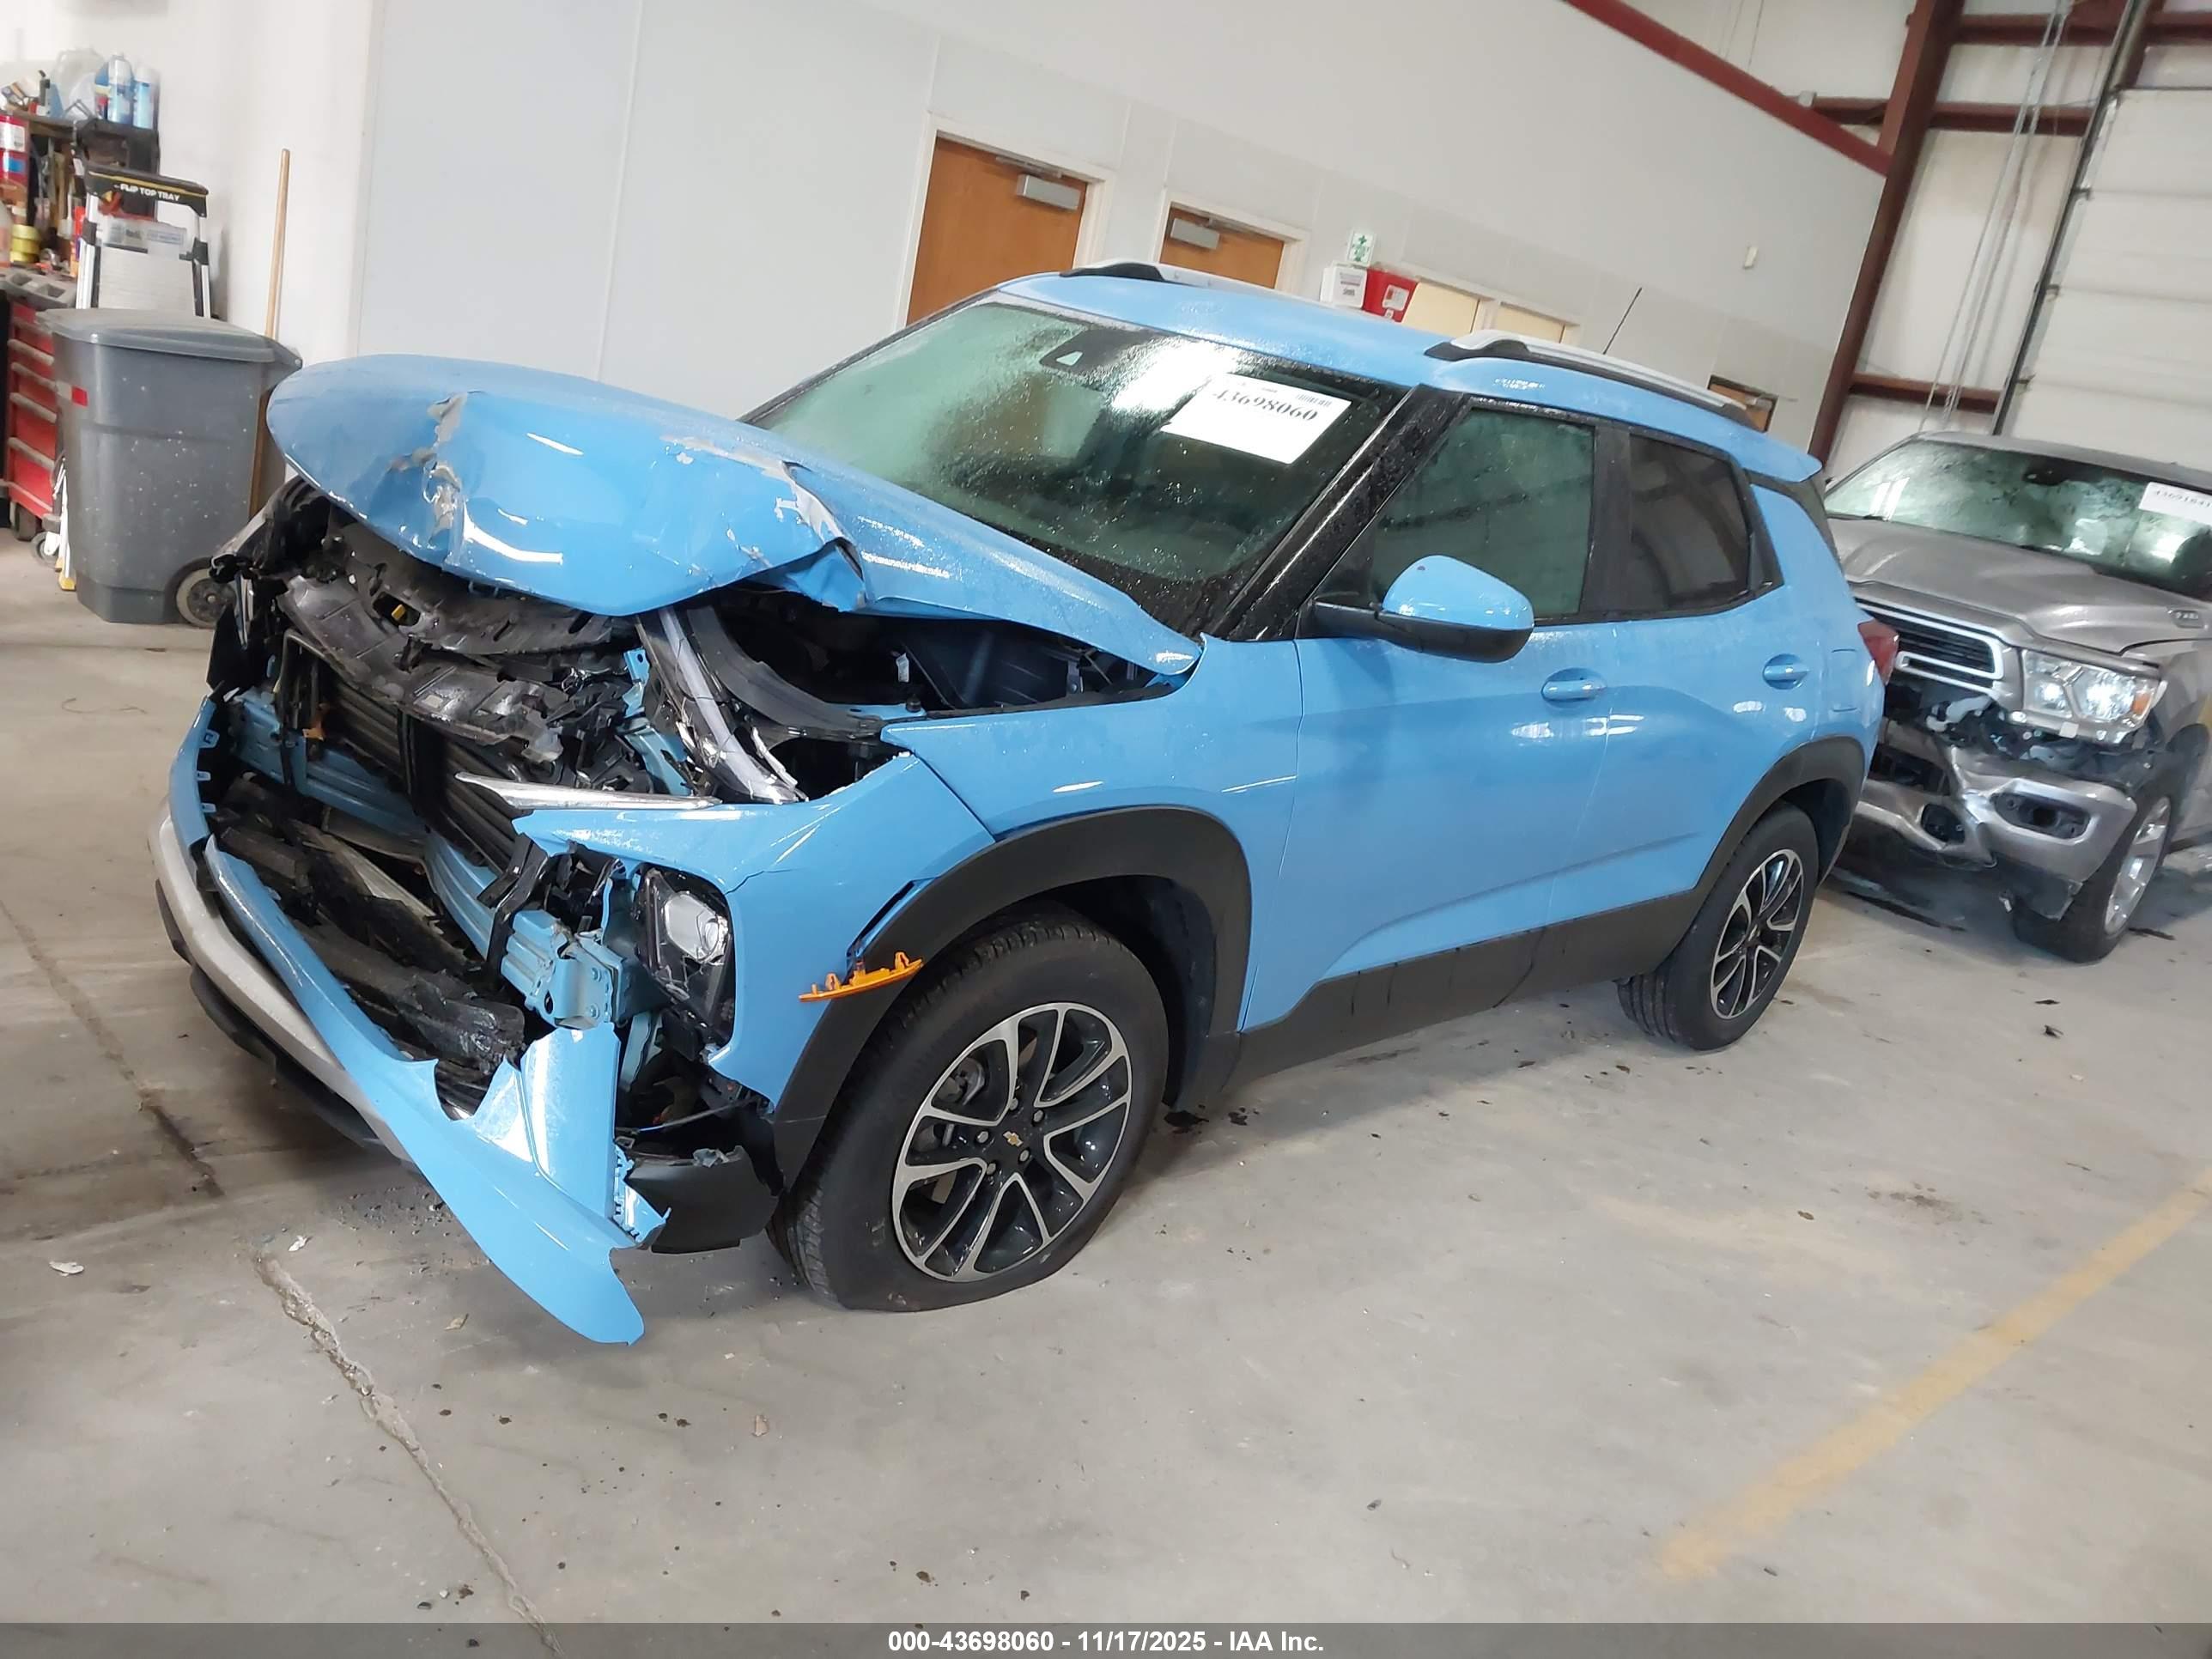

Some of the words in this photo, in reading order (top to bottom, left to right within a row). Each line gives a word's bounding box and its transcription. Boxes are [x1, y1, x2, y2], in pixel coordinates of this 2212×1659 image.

[120, 183, 139, 192] FLIP
[140, 187, 157, 197] TOP
[158, 191, 180, 201] TRAY
